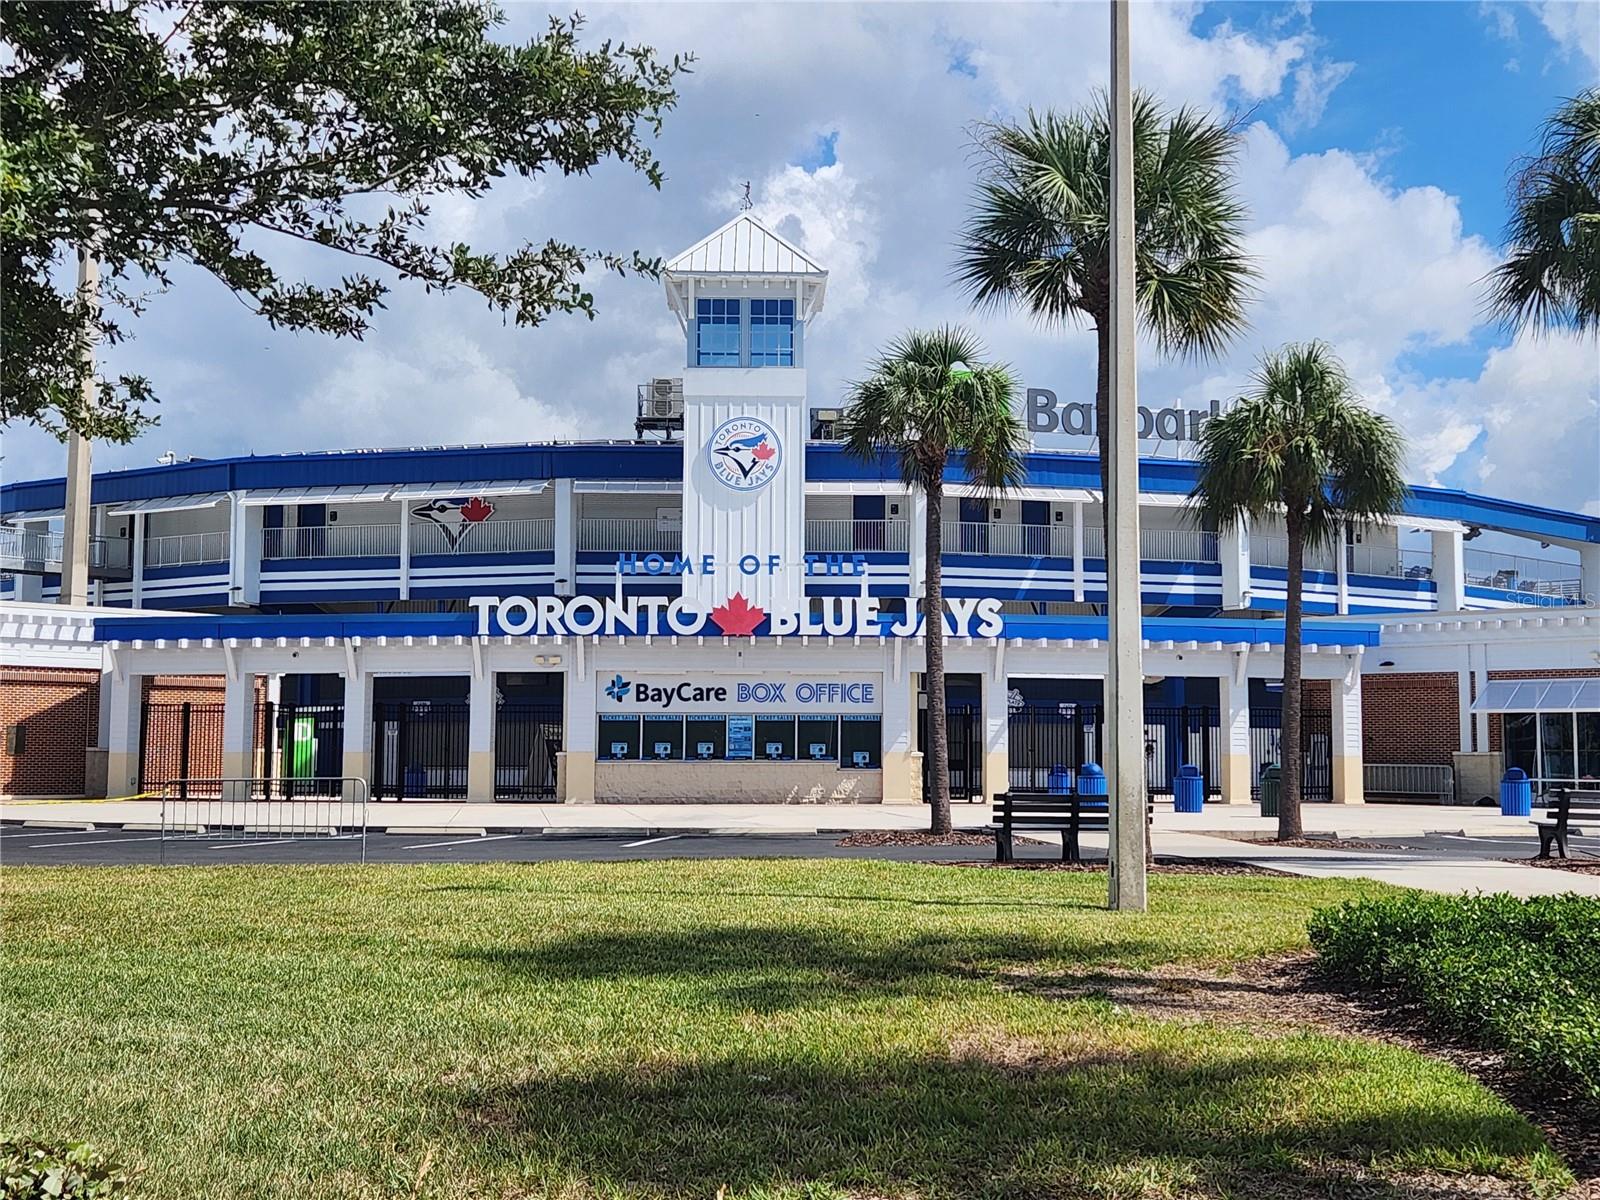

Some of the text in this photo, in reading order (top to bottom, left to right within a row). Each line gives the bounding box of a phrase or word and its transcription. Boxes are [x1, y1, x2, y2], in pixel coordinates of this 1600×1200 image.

[715, 422, 761, 446] TORONTO
[714, 461, 774, 486] BLUE JAYS
[618, 553, 866, 577] HOME OF THE
[468, 595, 708, 636] TORONTO
[768, 596, 882, 636] BLUE
[635, 682, 875, 708] BayCare BOX OFFICE
